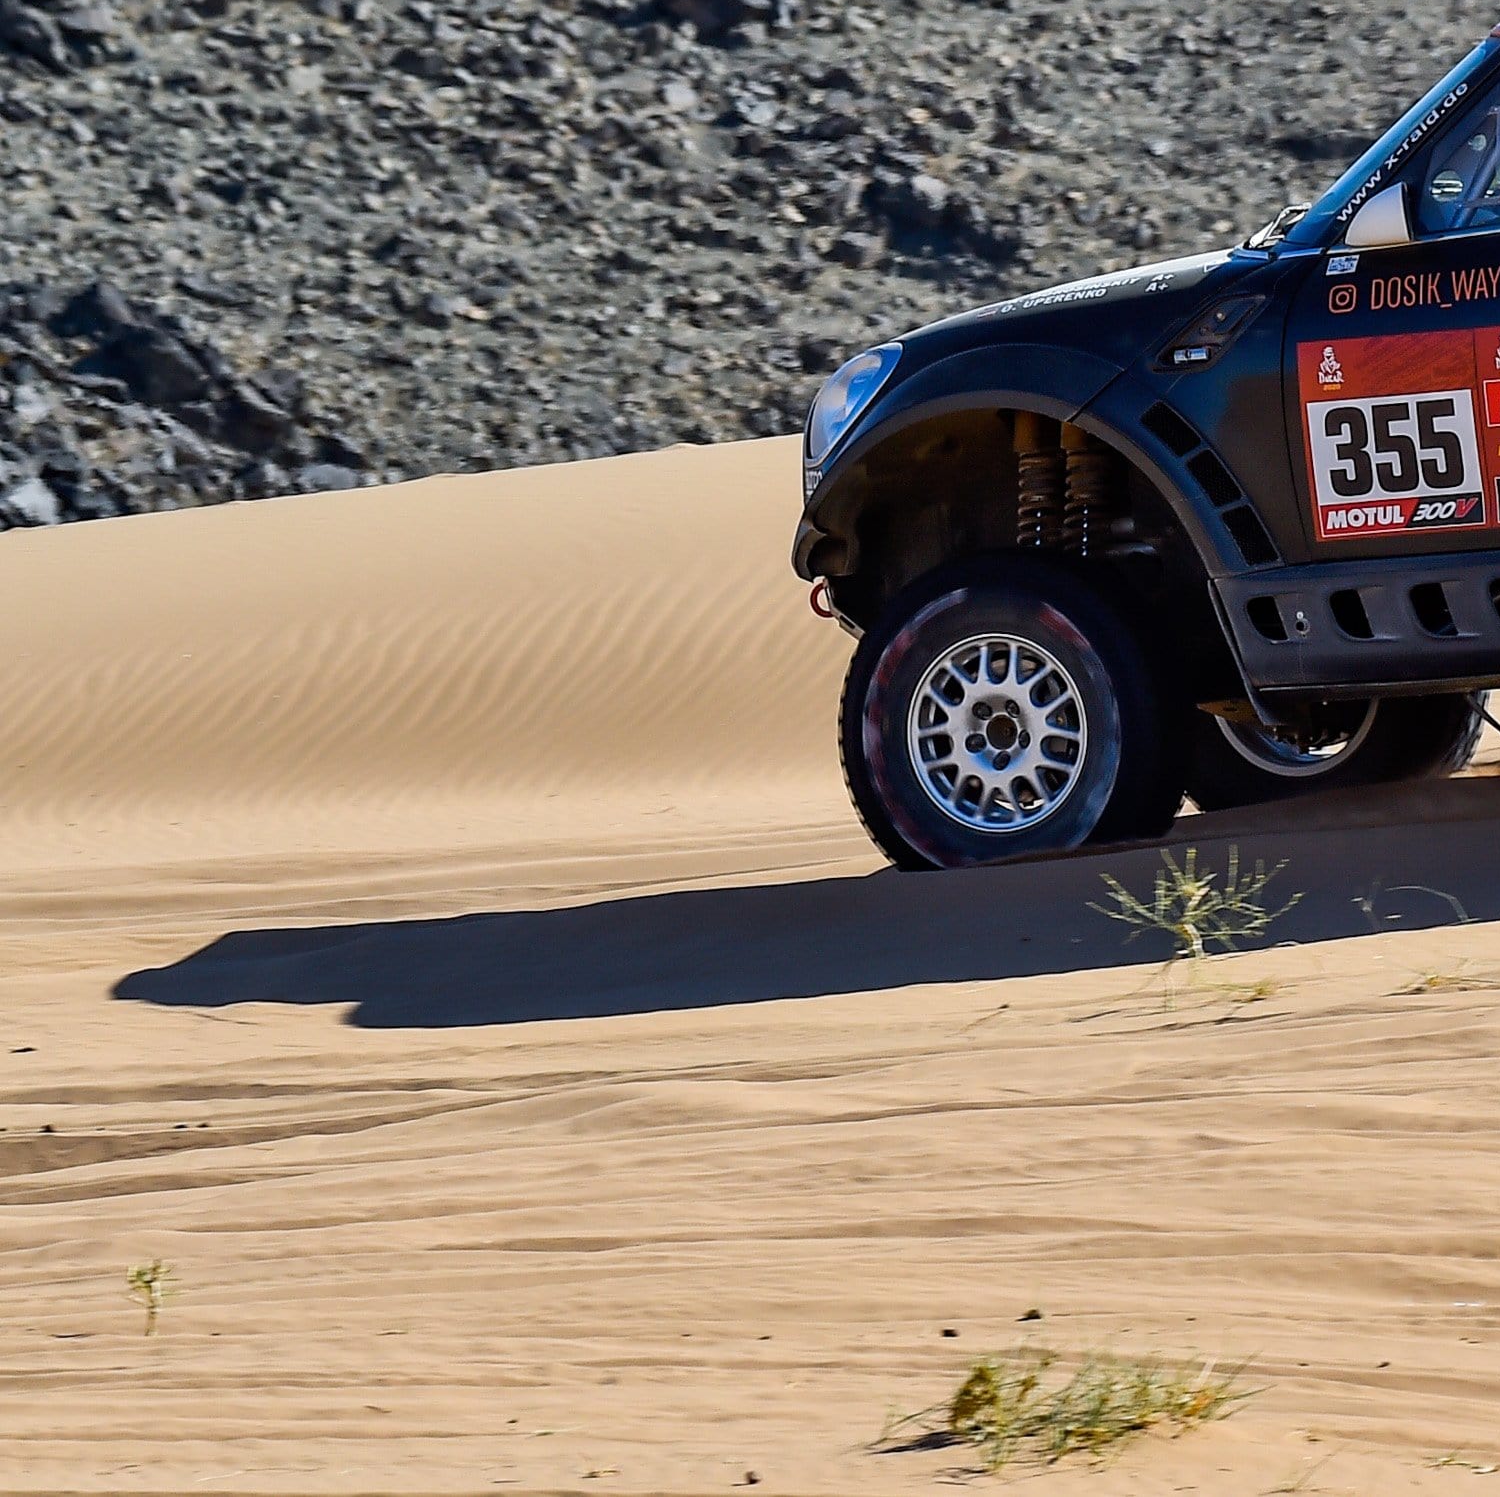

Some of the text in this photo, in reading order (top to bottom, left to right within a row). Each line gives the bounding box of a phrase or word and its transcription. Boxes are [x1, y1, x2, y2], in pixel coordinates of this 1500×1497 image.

[1144, 281, 1170, 293] A+
[1324, 398, 1465, 497] 355
[1325, 497, 1479, 531] MOTUL 300V
